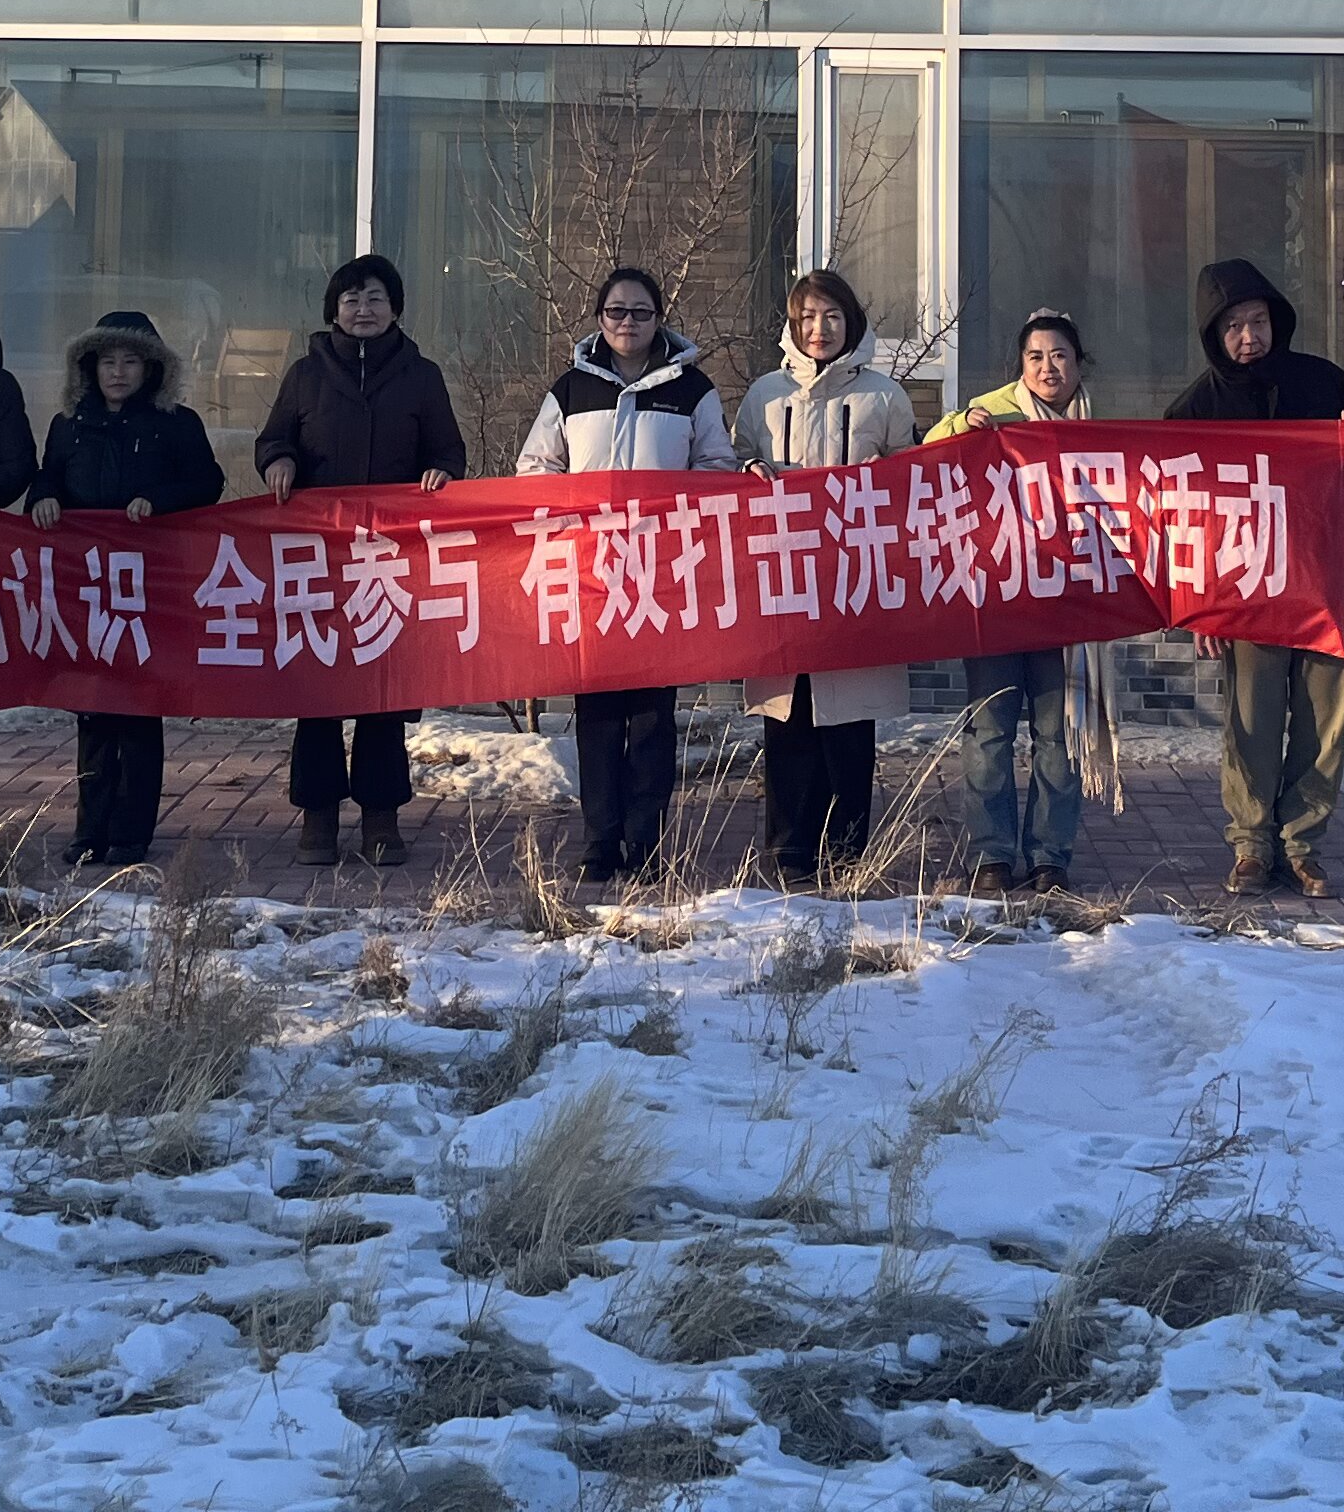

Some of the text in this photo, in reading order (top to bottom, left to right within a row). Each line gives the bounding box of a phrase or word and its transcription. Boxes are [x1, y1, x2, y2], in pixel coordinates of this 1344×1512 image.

[193, 519, 481, 671] 全民参与
[511, 451, 1288, 645] 有效打击洗钱犯罪活动
